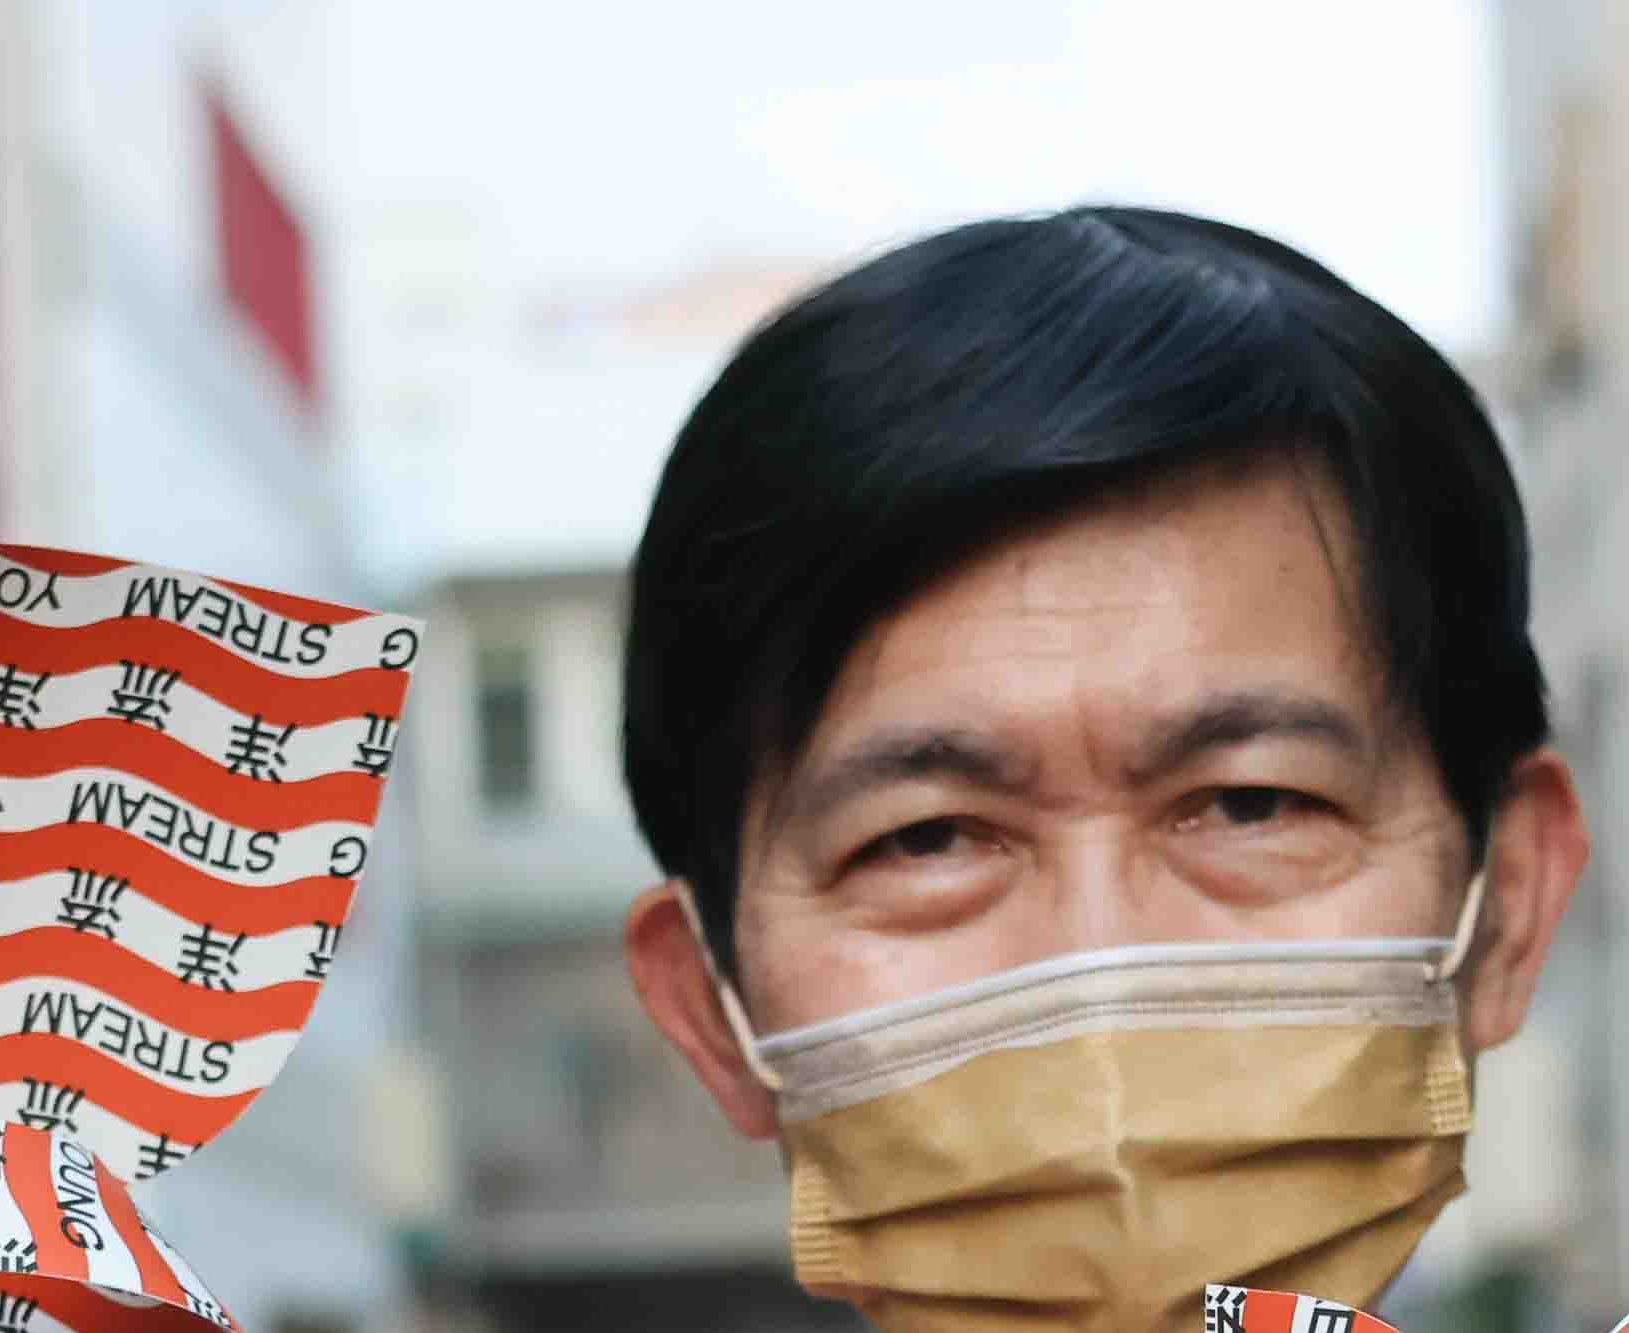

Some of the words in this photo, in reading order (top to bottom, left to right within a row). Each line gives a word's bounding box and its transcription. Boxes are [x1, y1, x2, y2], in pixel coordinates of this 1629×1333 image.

[117, 576, 333, 666] STREAM
[67, 782, 279, 873] STREAM
[21, 992, 234, 1083] STREAM
[57, 1141, 105, 1251] OUNG
